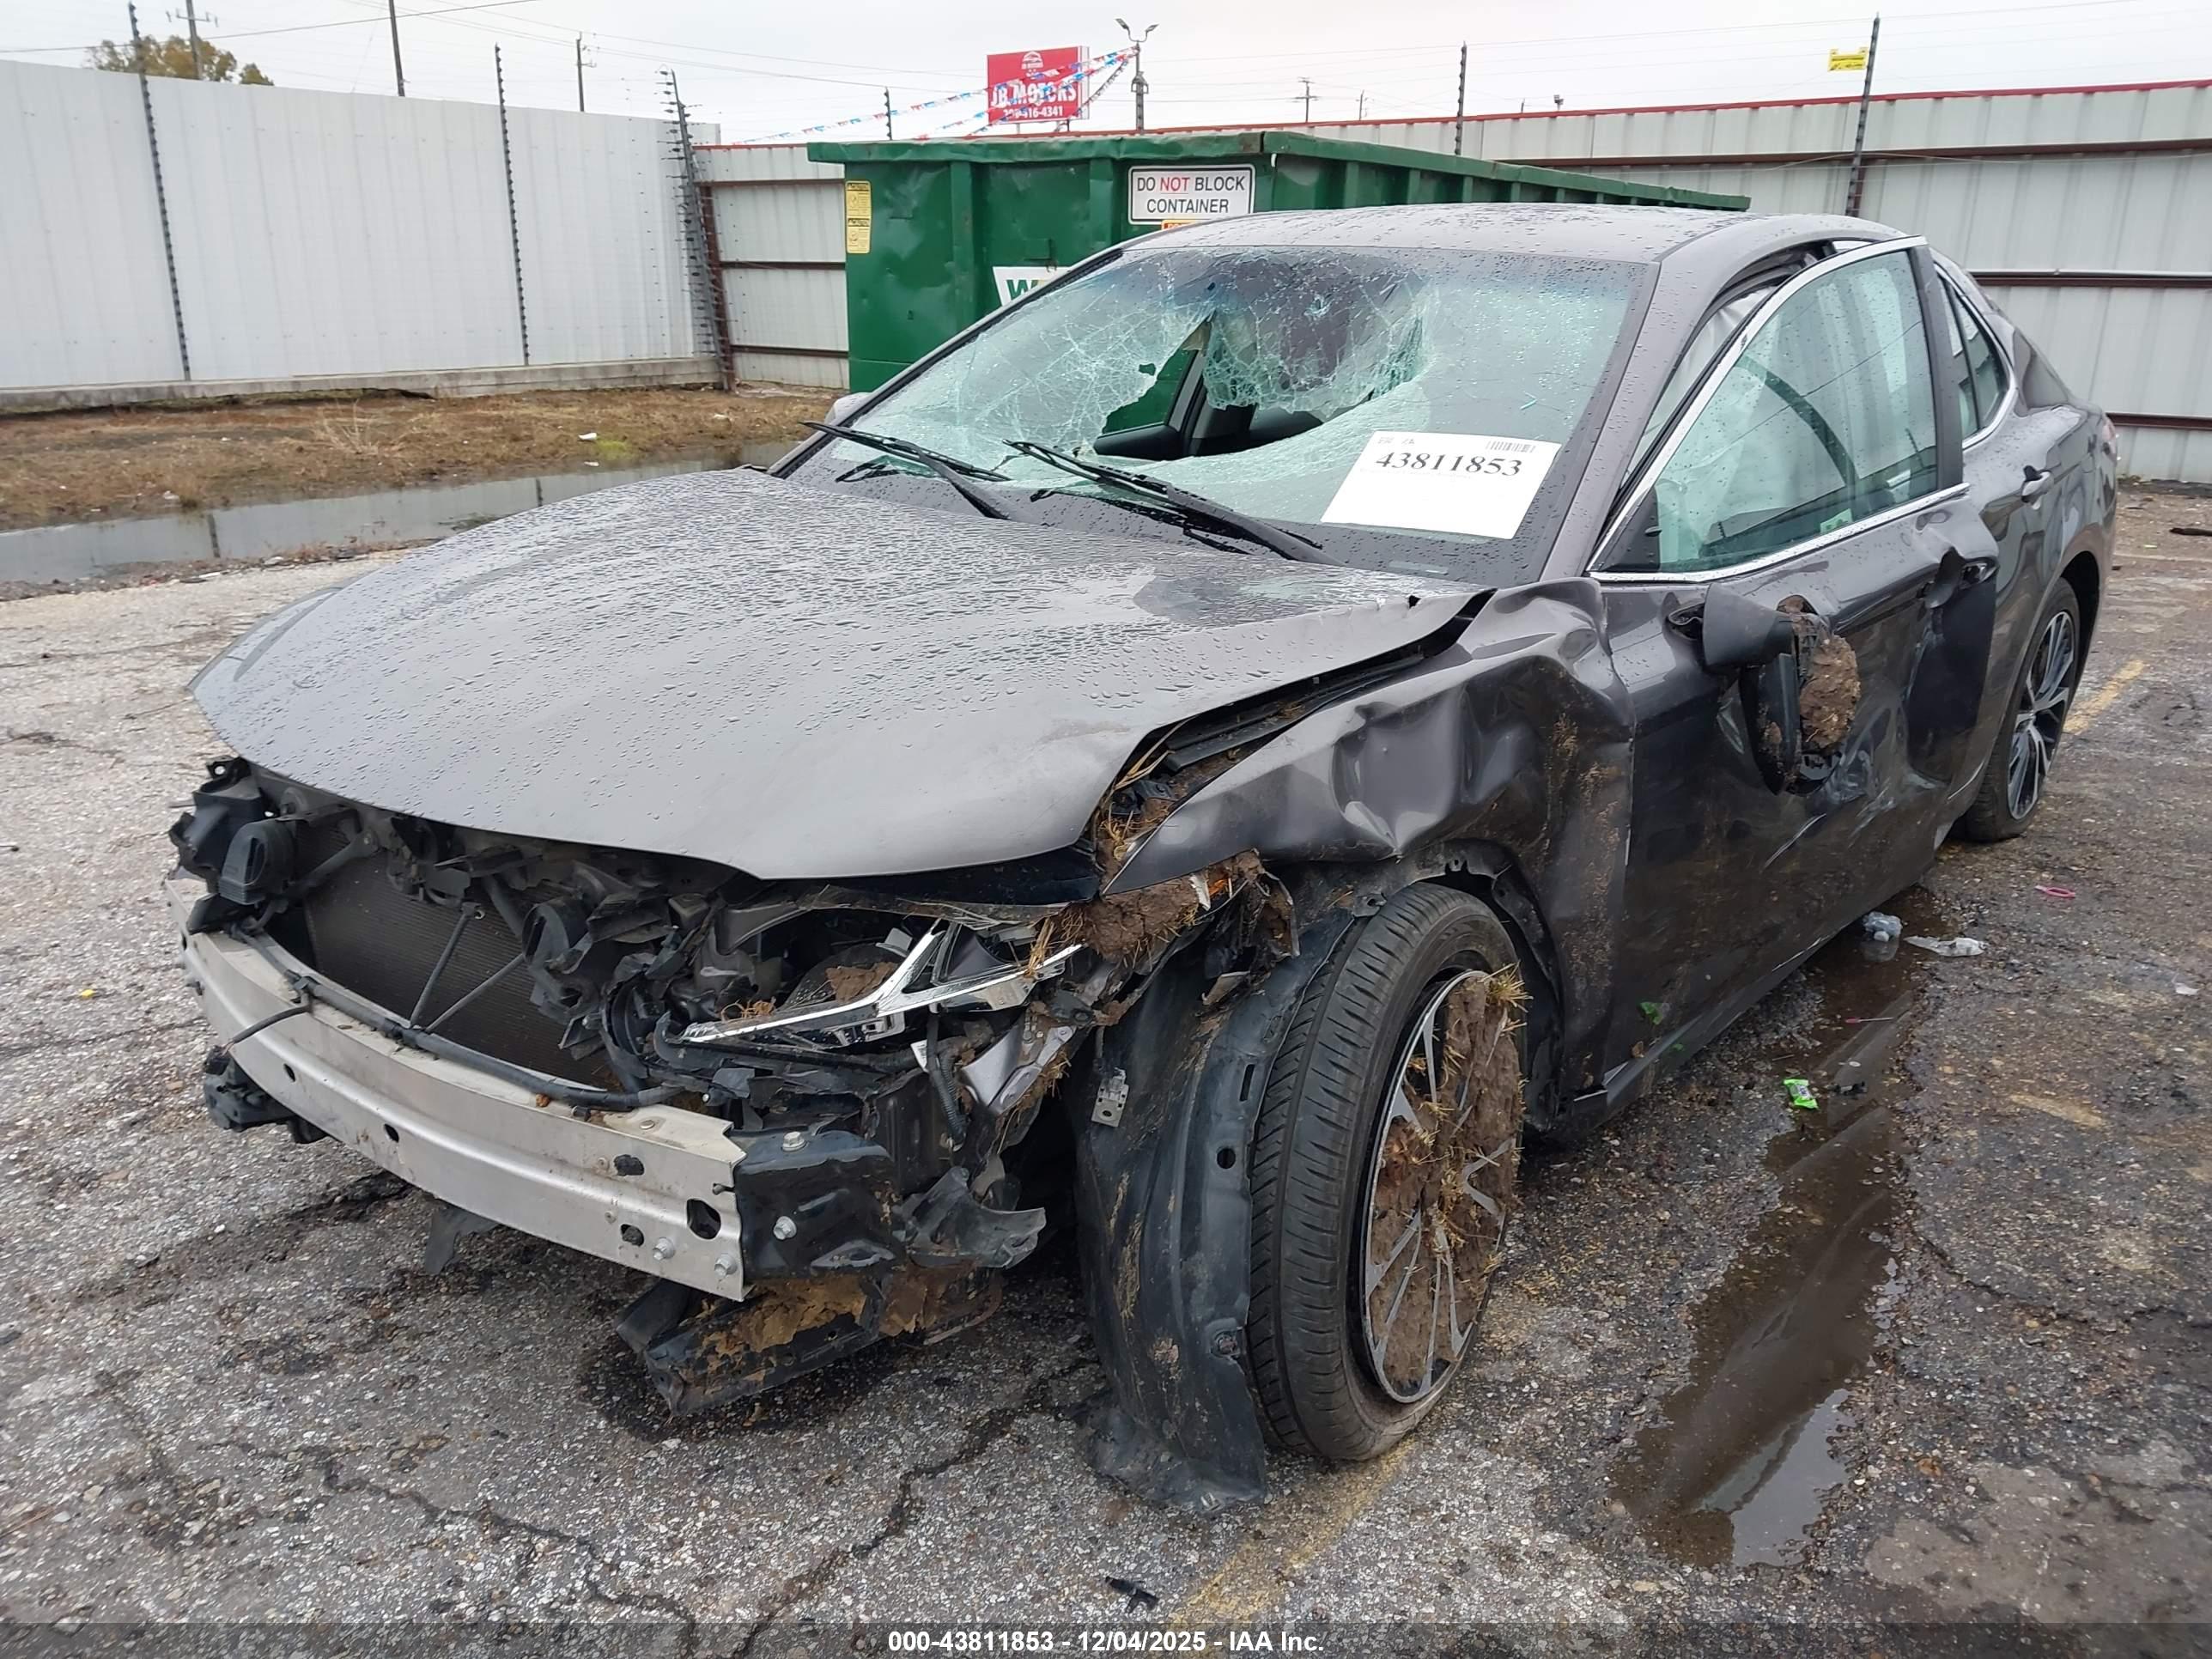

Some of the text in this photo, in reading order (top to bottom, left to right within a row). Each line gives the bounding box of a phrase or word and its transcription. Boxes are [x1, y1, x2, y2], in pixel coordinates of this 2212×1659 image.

[1003, 106, 1063, 118] 2-416-4341
[1137, 176, 1245, 191] DO NOT BLOCK
[1147, 198, 1229, 213] CONTAINER
[1376, 452, 1522, 477] 43811853
